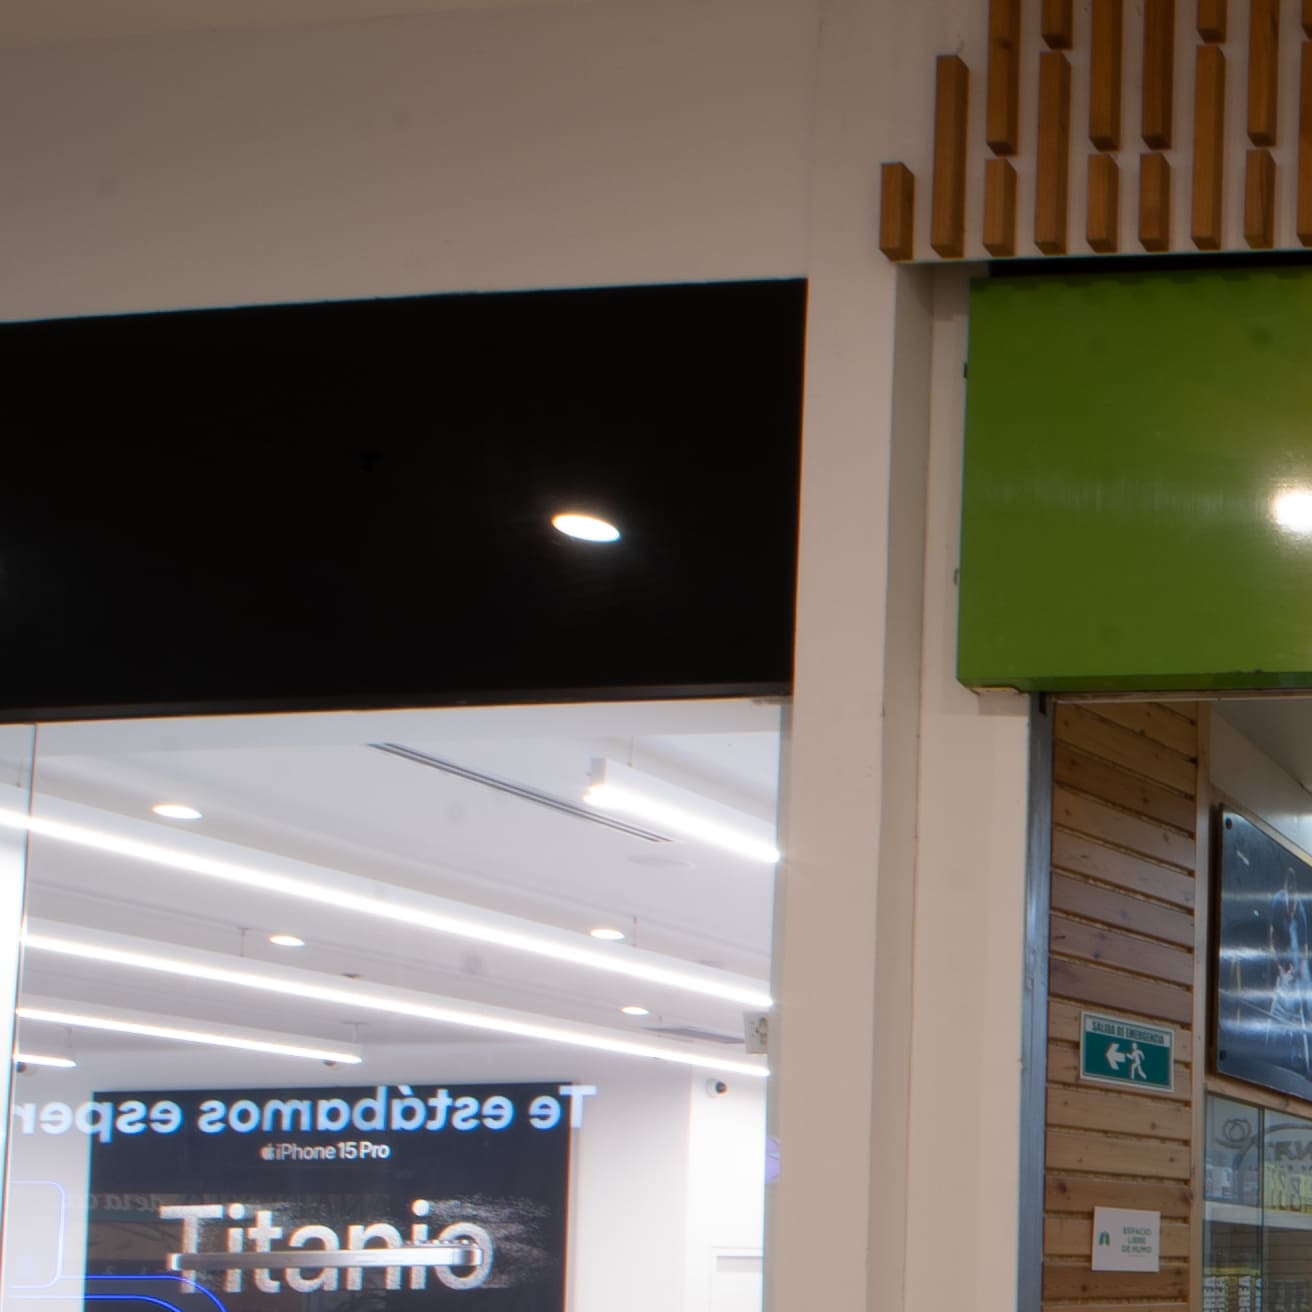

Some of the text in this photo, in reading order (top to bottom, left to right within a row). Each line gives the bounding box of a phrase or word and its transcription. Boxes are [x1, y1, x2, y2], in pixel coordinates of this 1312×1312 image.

[275, 1141, 391, 1161] iPhone 15 Pro
[160, 1199, 494, 1293] Titanio
